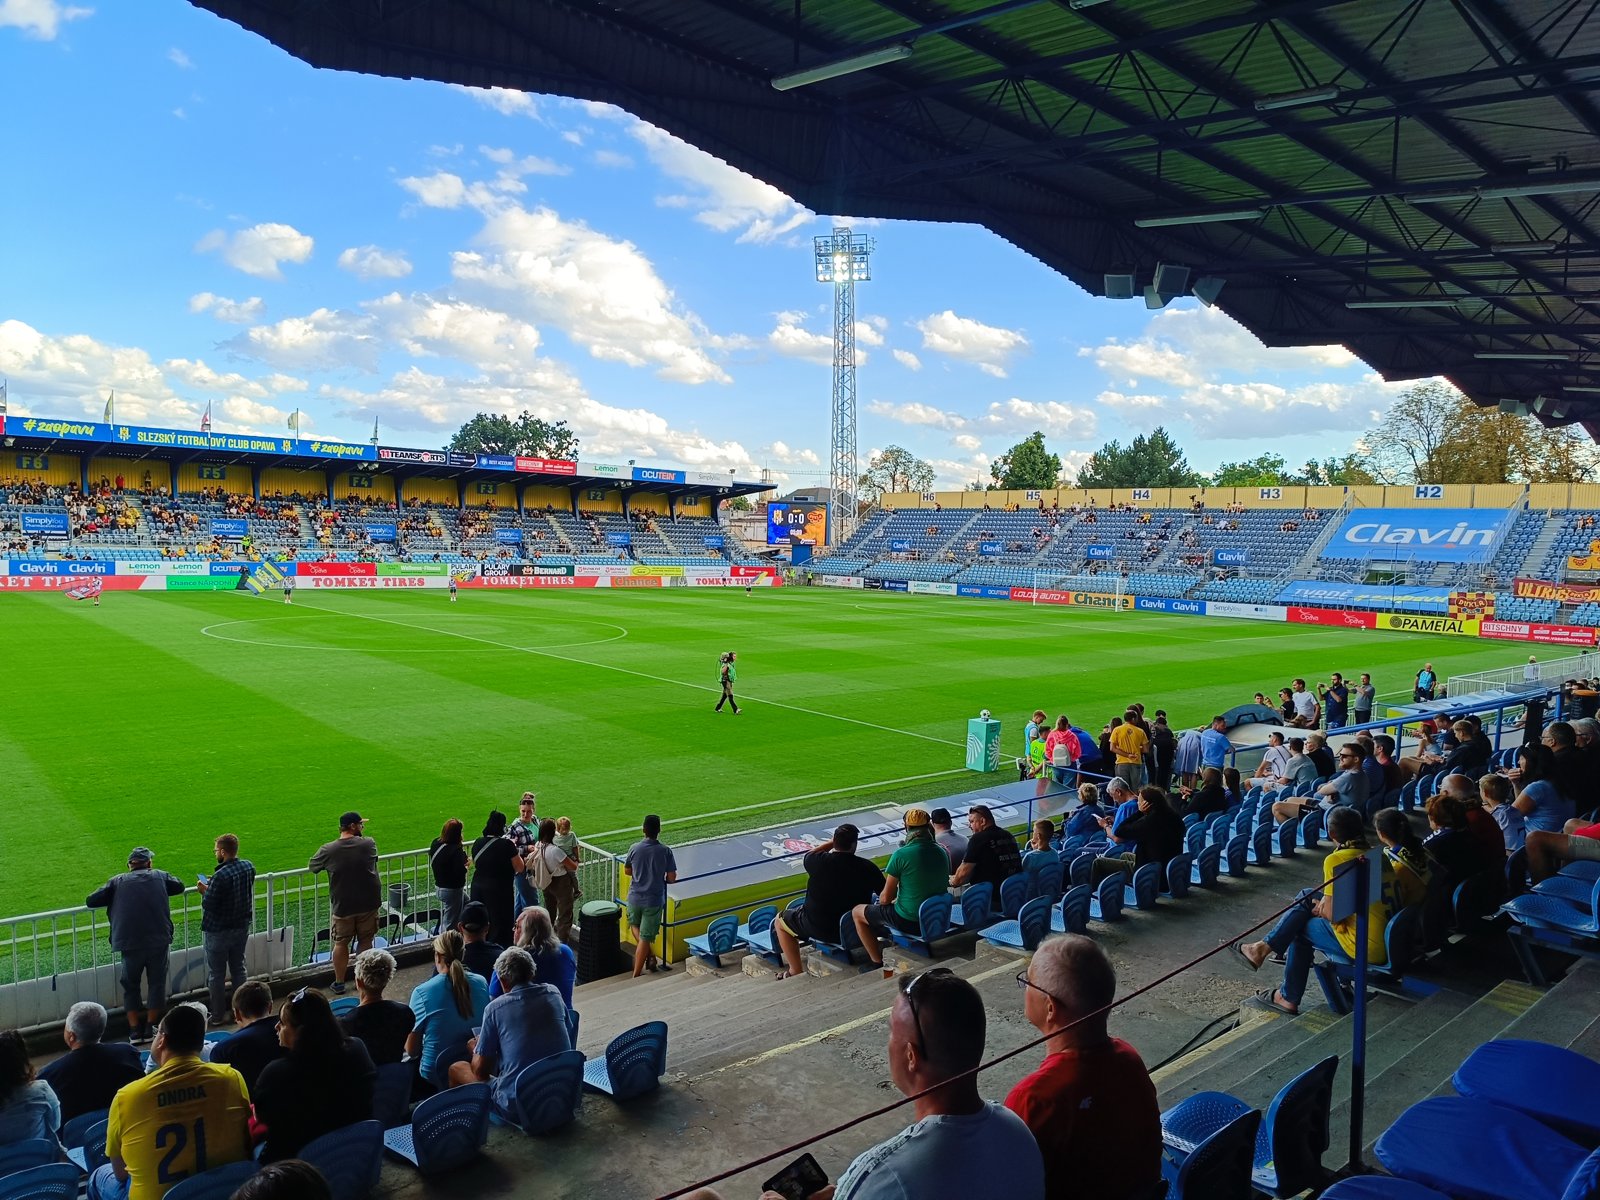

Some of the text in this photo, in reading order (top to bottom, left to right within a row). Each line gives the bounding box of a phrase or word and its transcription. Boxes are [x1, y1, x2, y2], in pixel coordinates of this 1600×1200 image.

[23, 419, 95, 438] #zaopavu
[138, 431, 276, 451] SLEZSKÝ FOTBALOVÝ CLUB OPAVA
[203, 467, 220, 479] F5
[594, 465, 618, 473] Lemon
[642, 471, 675, 480] OCUTEIN
[353, 476, 368, 487] F4
[480, 484, 494, 493] F3
[1260, 488, 1280, 499] H3
[1415, 486, 1441, 498] H2
[590, 490, 601, 500] F2
[922, 493, 935, 501] H6
[1026, 491, 1040, 500] H5
[1133, 490, 1150, 499] H4
[25, 516, 63, 525] SimplyYou
[788, 513, 804, 524] 0:0
[211, 521, 243, 530] SimplyYou
[1345, 521, 1495, 546] Clavin
[982, 542, 1002, 552] Clavin
[1090, 545, 1112, 556] Clavin
[1217, 551, 1245, 562] Clavin
[20, 562, 58, 573] Clavin
[69, 562, 106, 573] Clavin
[312, 577, 425, 587] TOMKET TIRES
[482, 576, 574, 585] TOMKET TIRES
[615, 576, 658, 587] Chance
[1140, 599, 1166, 609] Clavin
[1172, 601, 1199, 612] Clavin
[1483, 623, 1523, 632] RITSCHNY
[157, 1085, 207, 1107] ONDRA
[156, 1116, 208, 1184] 21
